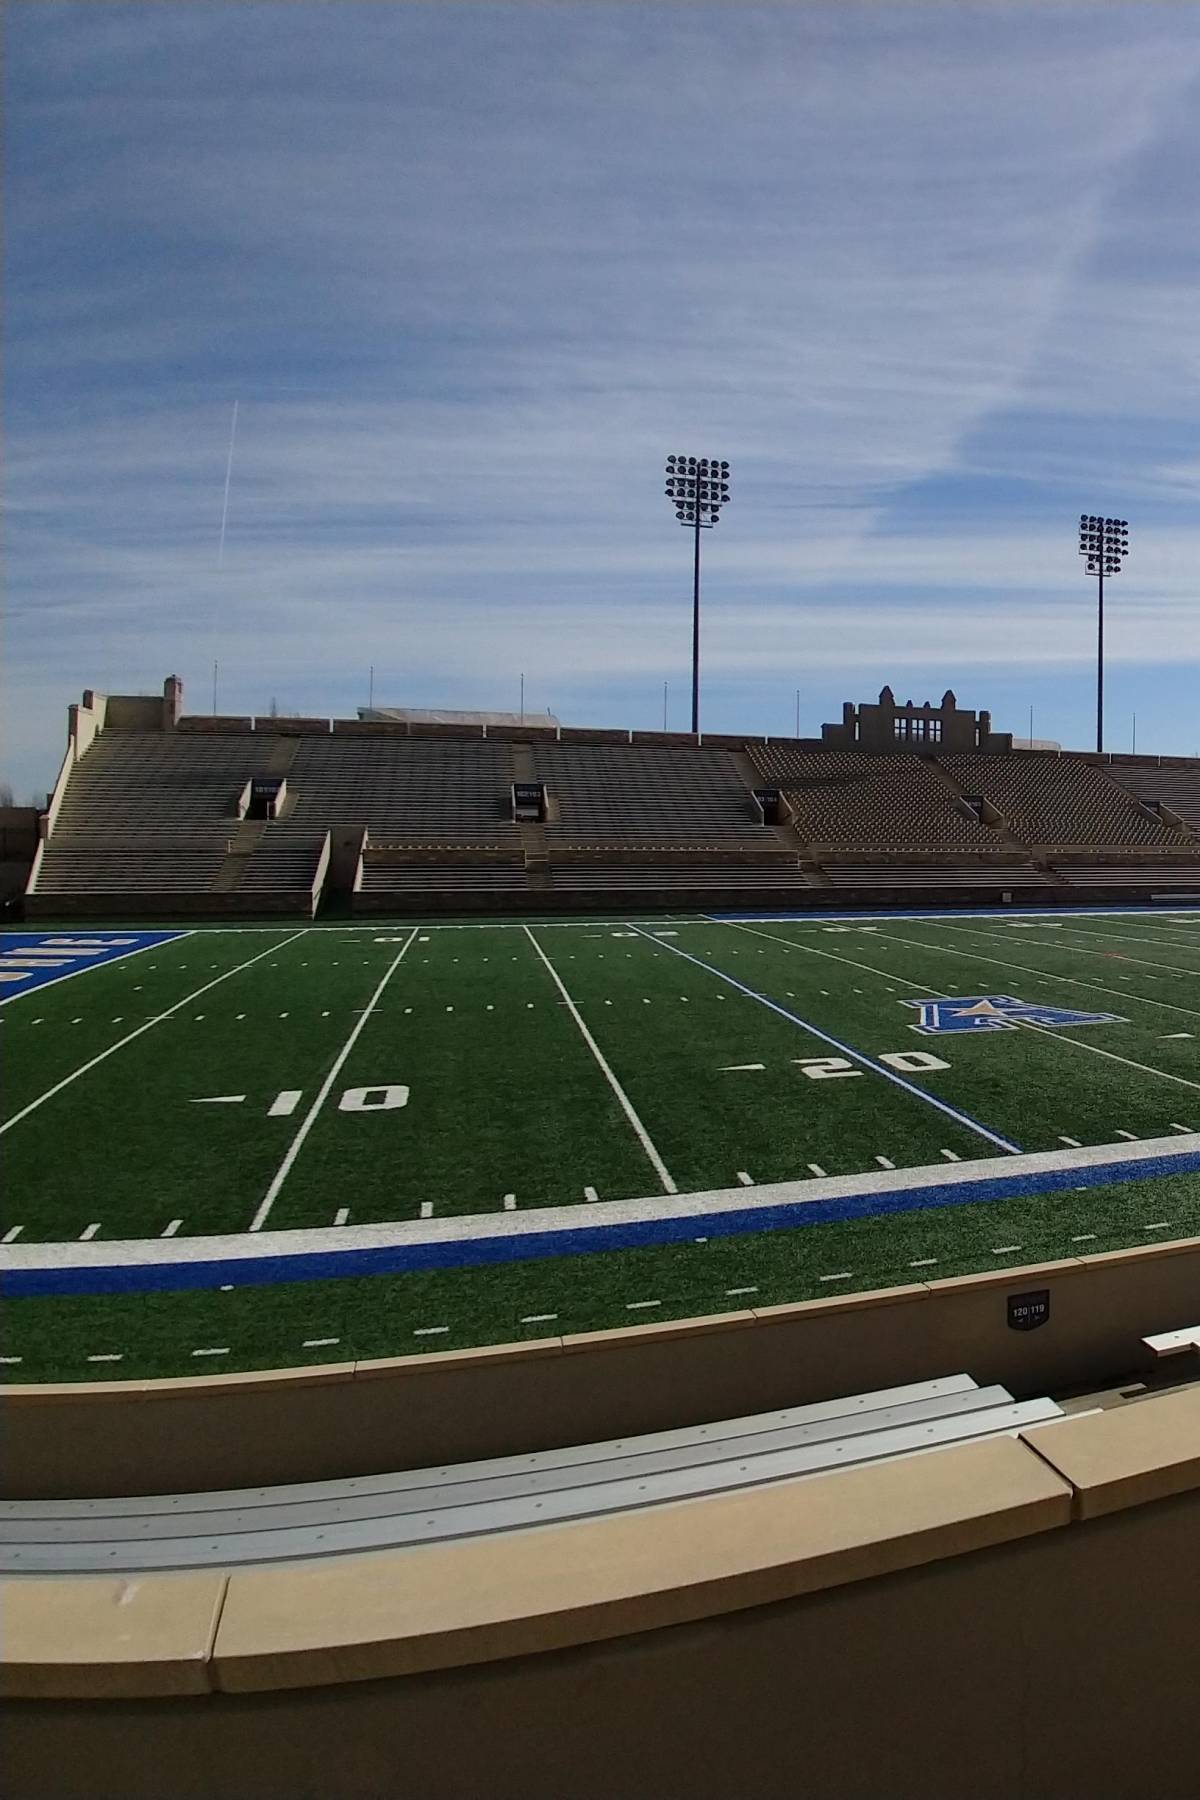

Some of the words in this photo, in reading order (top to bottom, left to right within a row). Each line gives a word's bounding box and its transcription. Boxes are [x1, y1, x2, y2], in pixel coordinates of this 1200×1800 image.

[791, 1052, 952, 1079] 20
[267, 1085, 410, 1116] 10
[1013, 1306, 1028, 1318] 120
